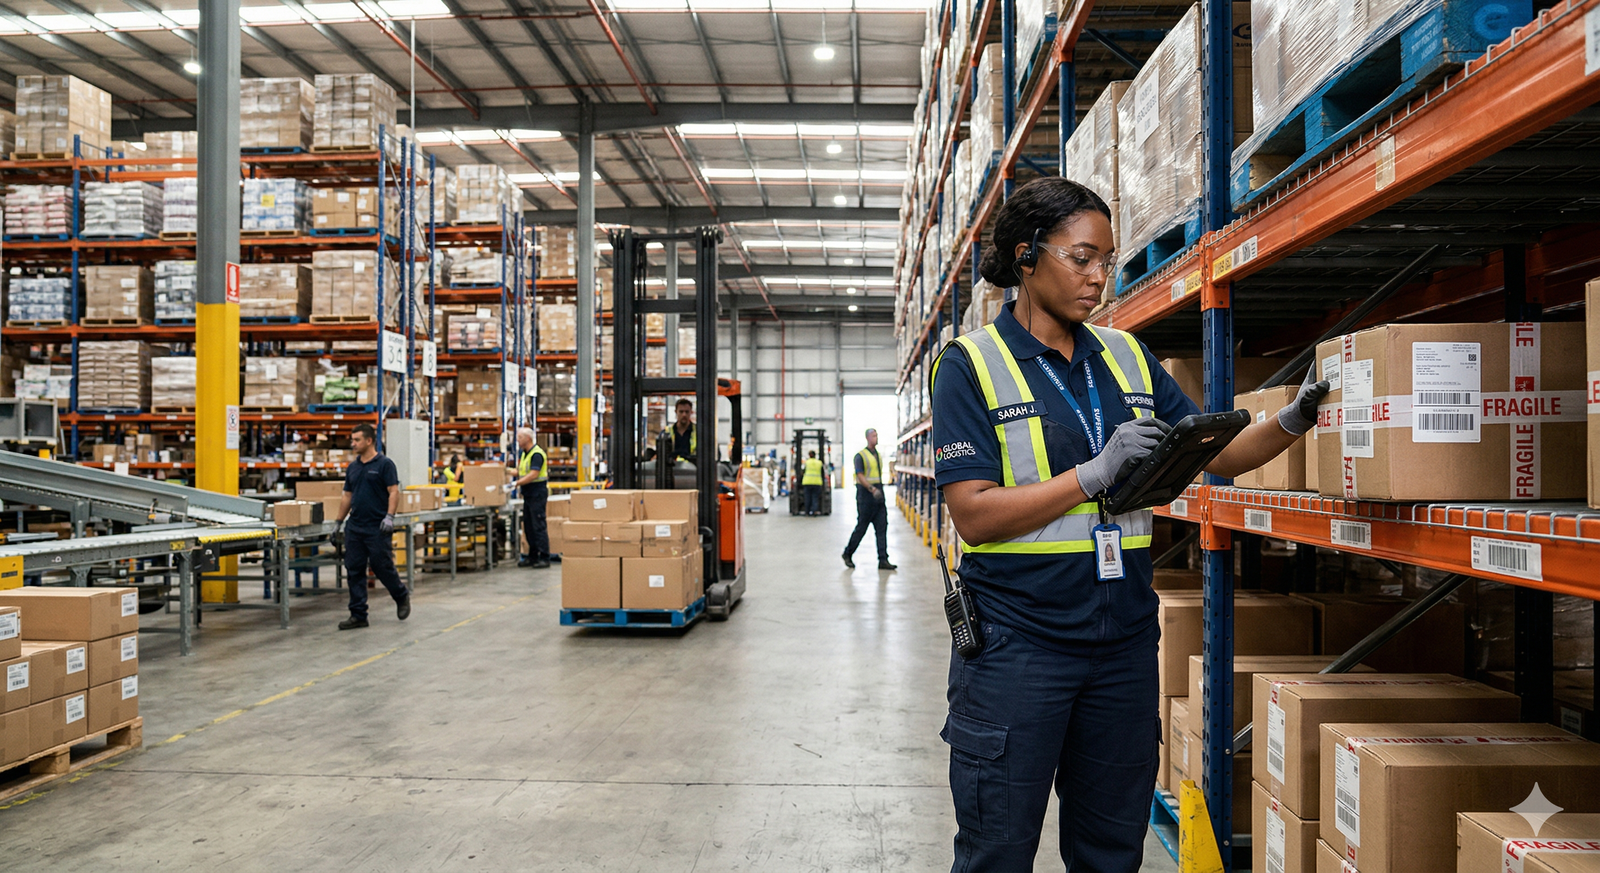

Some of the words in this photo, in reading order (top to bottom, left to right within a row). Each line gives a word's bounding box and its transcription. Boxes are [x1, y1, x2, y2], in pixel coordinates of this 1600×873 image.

[997, 405, 1028, 420] SARAH
[1027, 404, 1038, 415] J.
[1483, 397, 1561, 417] FRAGILE
[942, 441, 974, 453] GLOBAL
[943, 448, 976, 460] LOGISTICS
[1516, 424, 1534, 498] FRAGILE
[1506, 840, 1600, 861] FRAGILE
